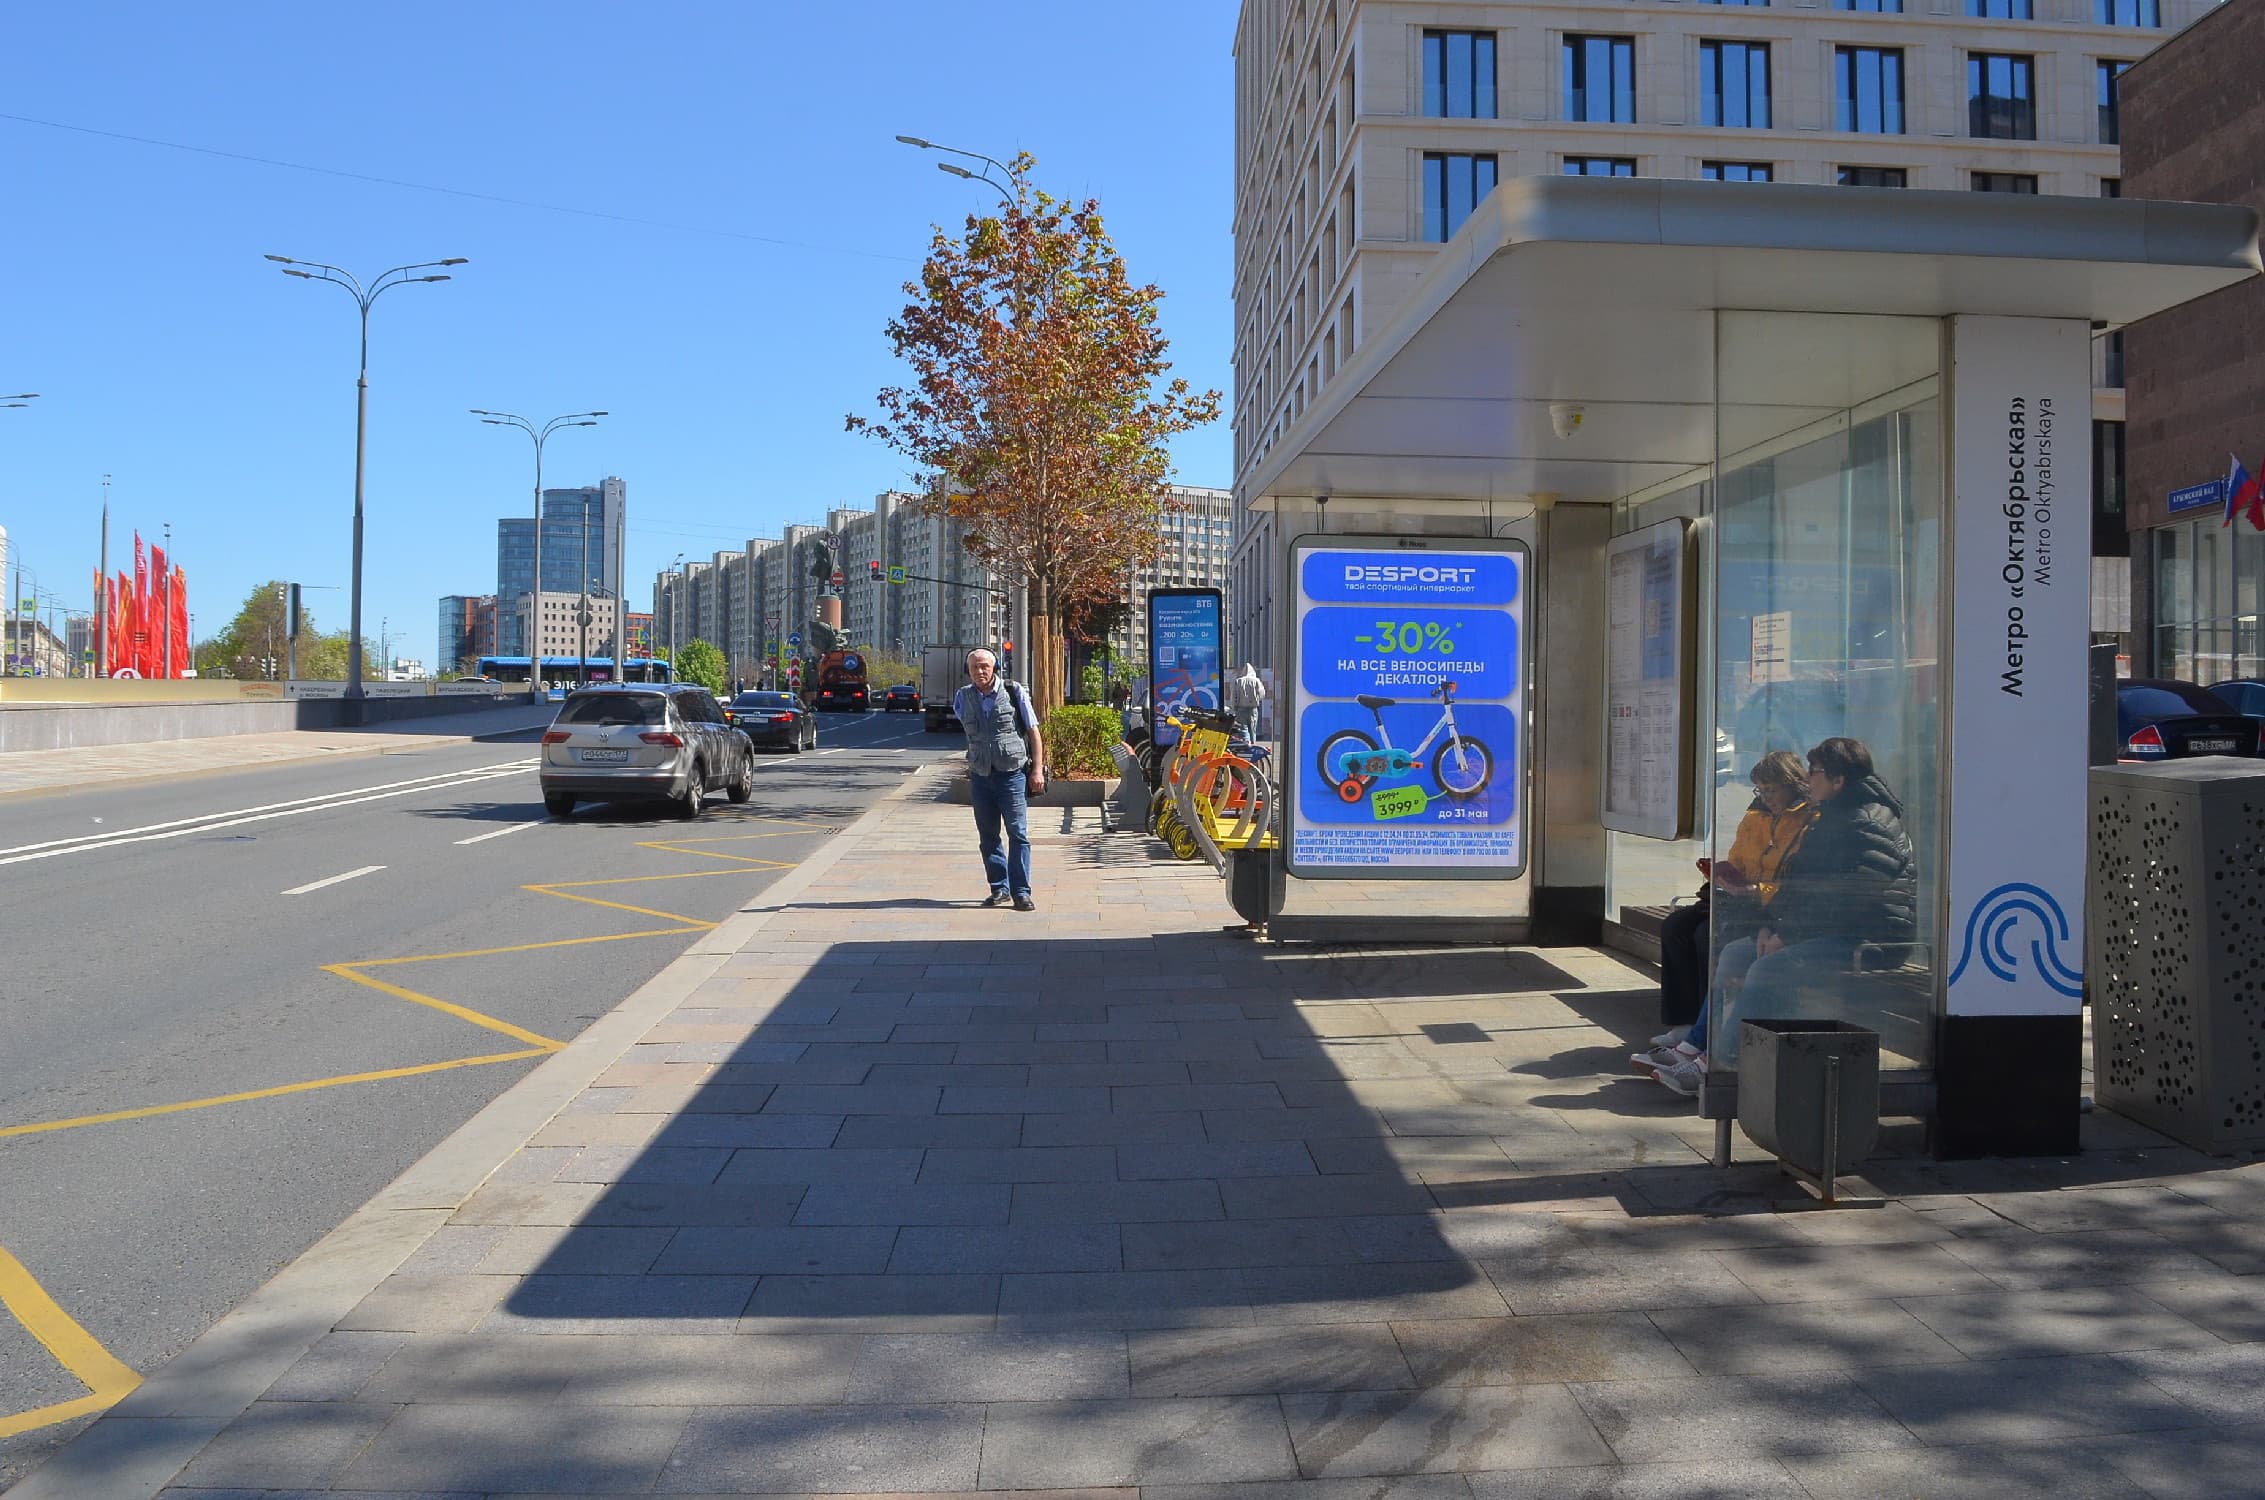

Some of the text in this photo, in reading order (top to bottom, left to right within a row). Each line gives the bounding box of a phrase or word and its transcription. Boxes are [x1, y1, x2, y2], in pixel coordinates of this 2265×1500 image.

[2033, 397, 2056, 586] Metro Oktyabrskaya
[2000, 396, 2030, 698] Метро «Октябрьская»
[1345, 565, 1476, 583] DESPORT
[1366, 583, 1417, 592] спортивный
[1196, 599, 1212, 608] ВТБ
[1337, 659, 1484, 674] НА ВСЕ ВЕЛОСИПЕДЫ
[1375, 673, 1447, 686] ДЕКАТЛОН
[1378, 801, 1412, 816] 3999
[1438, 808, 1488, 819] до 31 мая
